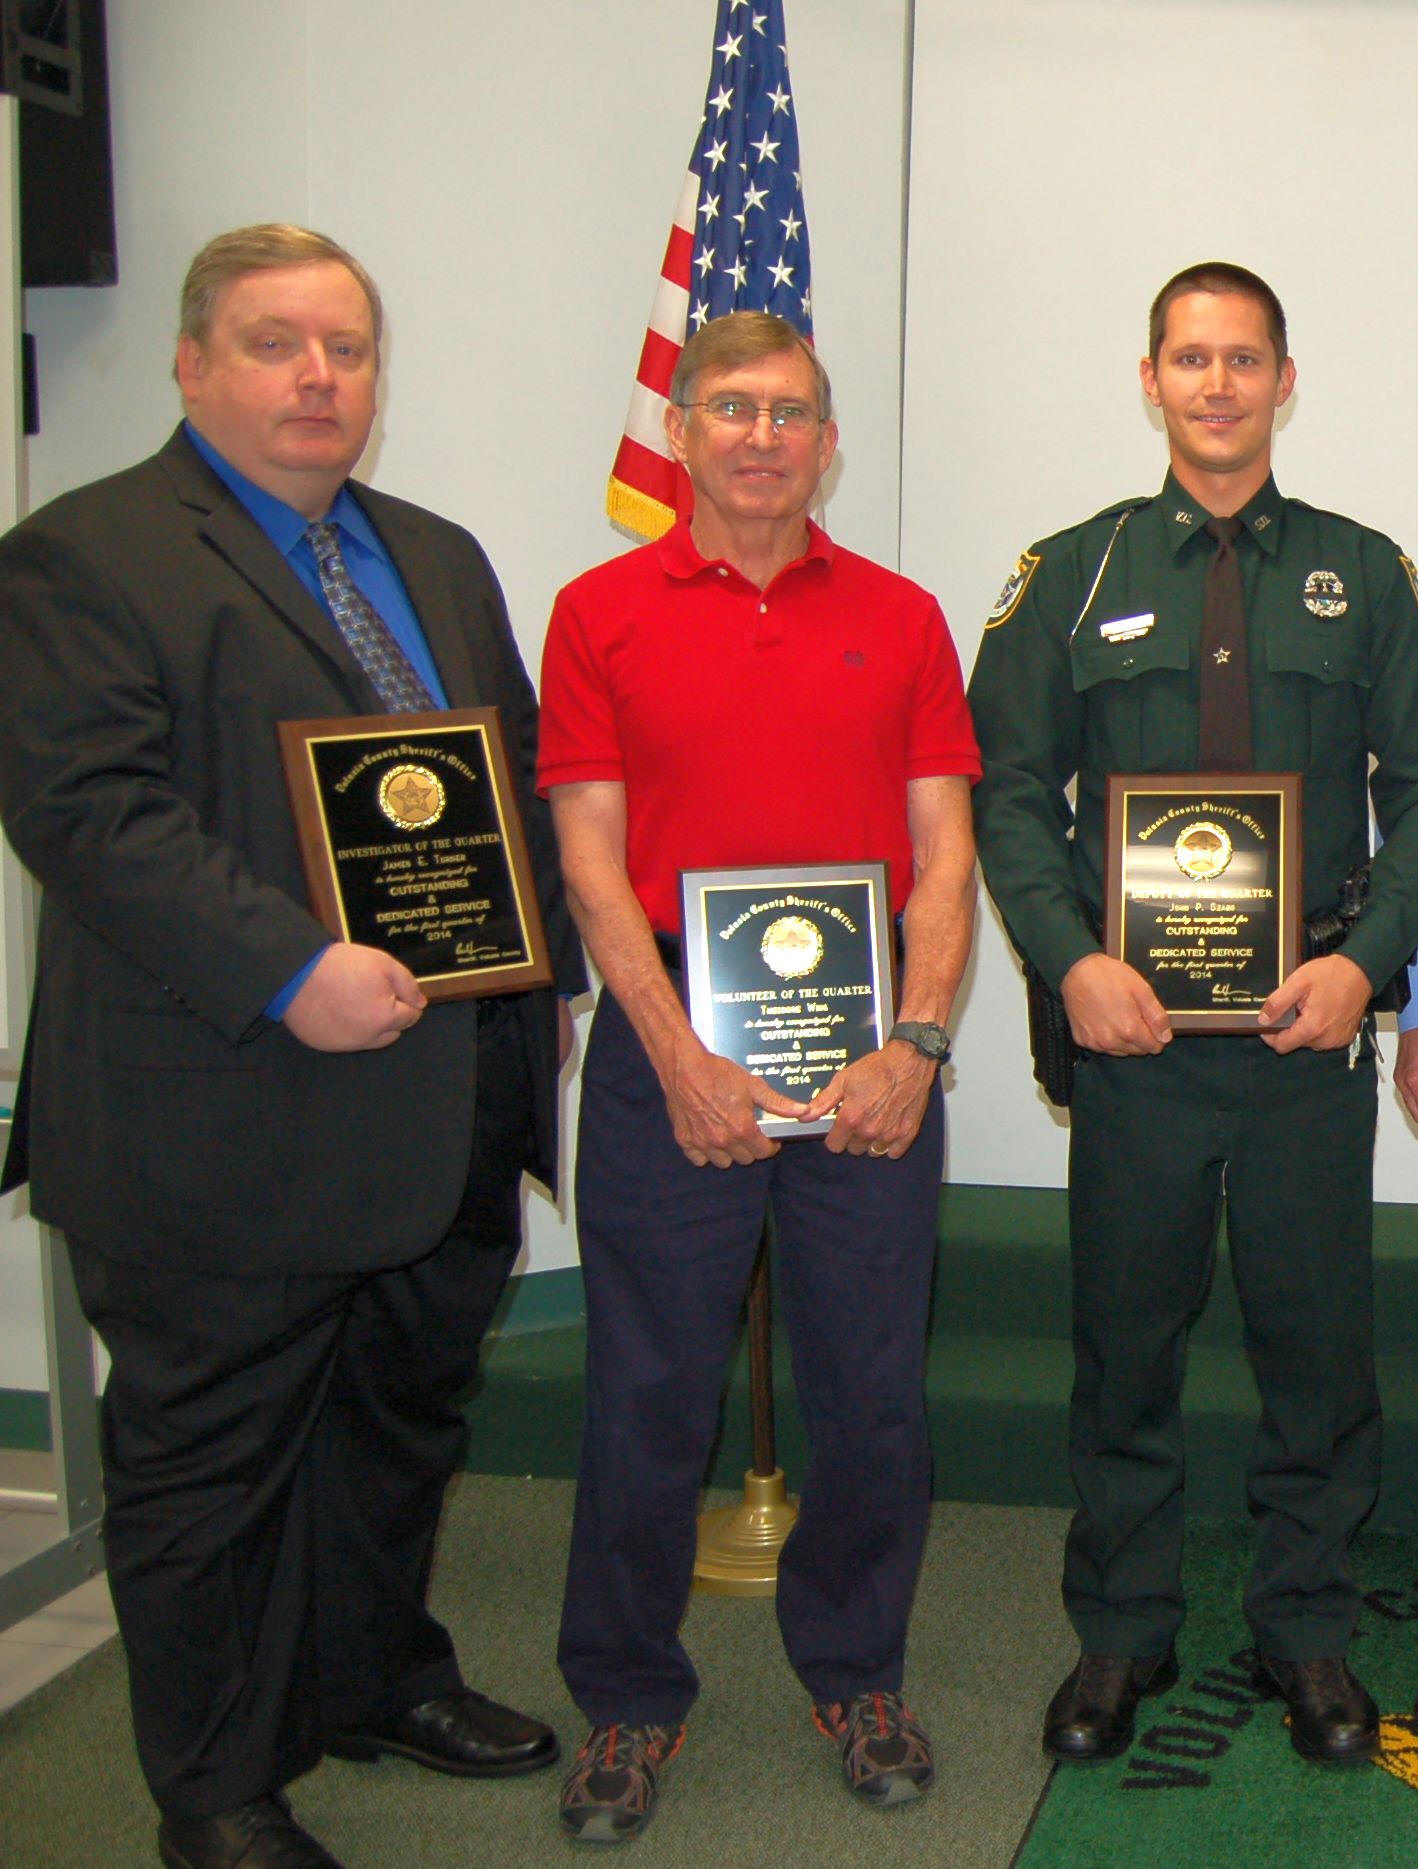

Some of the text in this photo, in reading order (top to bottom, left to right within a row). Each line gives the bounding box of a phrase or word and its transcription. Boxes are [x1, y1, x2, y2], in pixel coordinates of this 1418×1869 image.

[1167, 805, 1200, 818] County
[337, 833, 501, 859] INVESTIGATOR OF THE QUARTER
[389, 879, 469, 897] OUTSTANDING
[376, 900, 491, 923] DEDICATED SERVICE
[404, 923, 418, 932] the
[475, 914, 486, 925] of
[427, 930, 452, 941] 2014
[1165, 926, 1237, 935] OUTSTANDING
[1149, 948, 1253, 957] DEDICATED SERVICE
[1171, 961, 1184, 969] the
[1236, 961, 1247, 971] of
[1190, 971, 1212, 979] 2014
[712, 985, 872, 1003] VOLUNTEER OF THE QUARTER
[760, 1027, 831, 1040] OUTSTANDING
[746, 1049, 847, 1065] DEDICATED SERVICE
[765, 1067, 780, 1075] the
[835, 1062, 847, 1072] of
[786, 1076, 811, 1086] 2014
